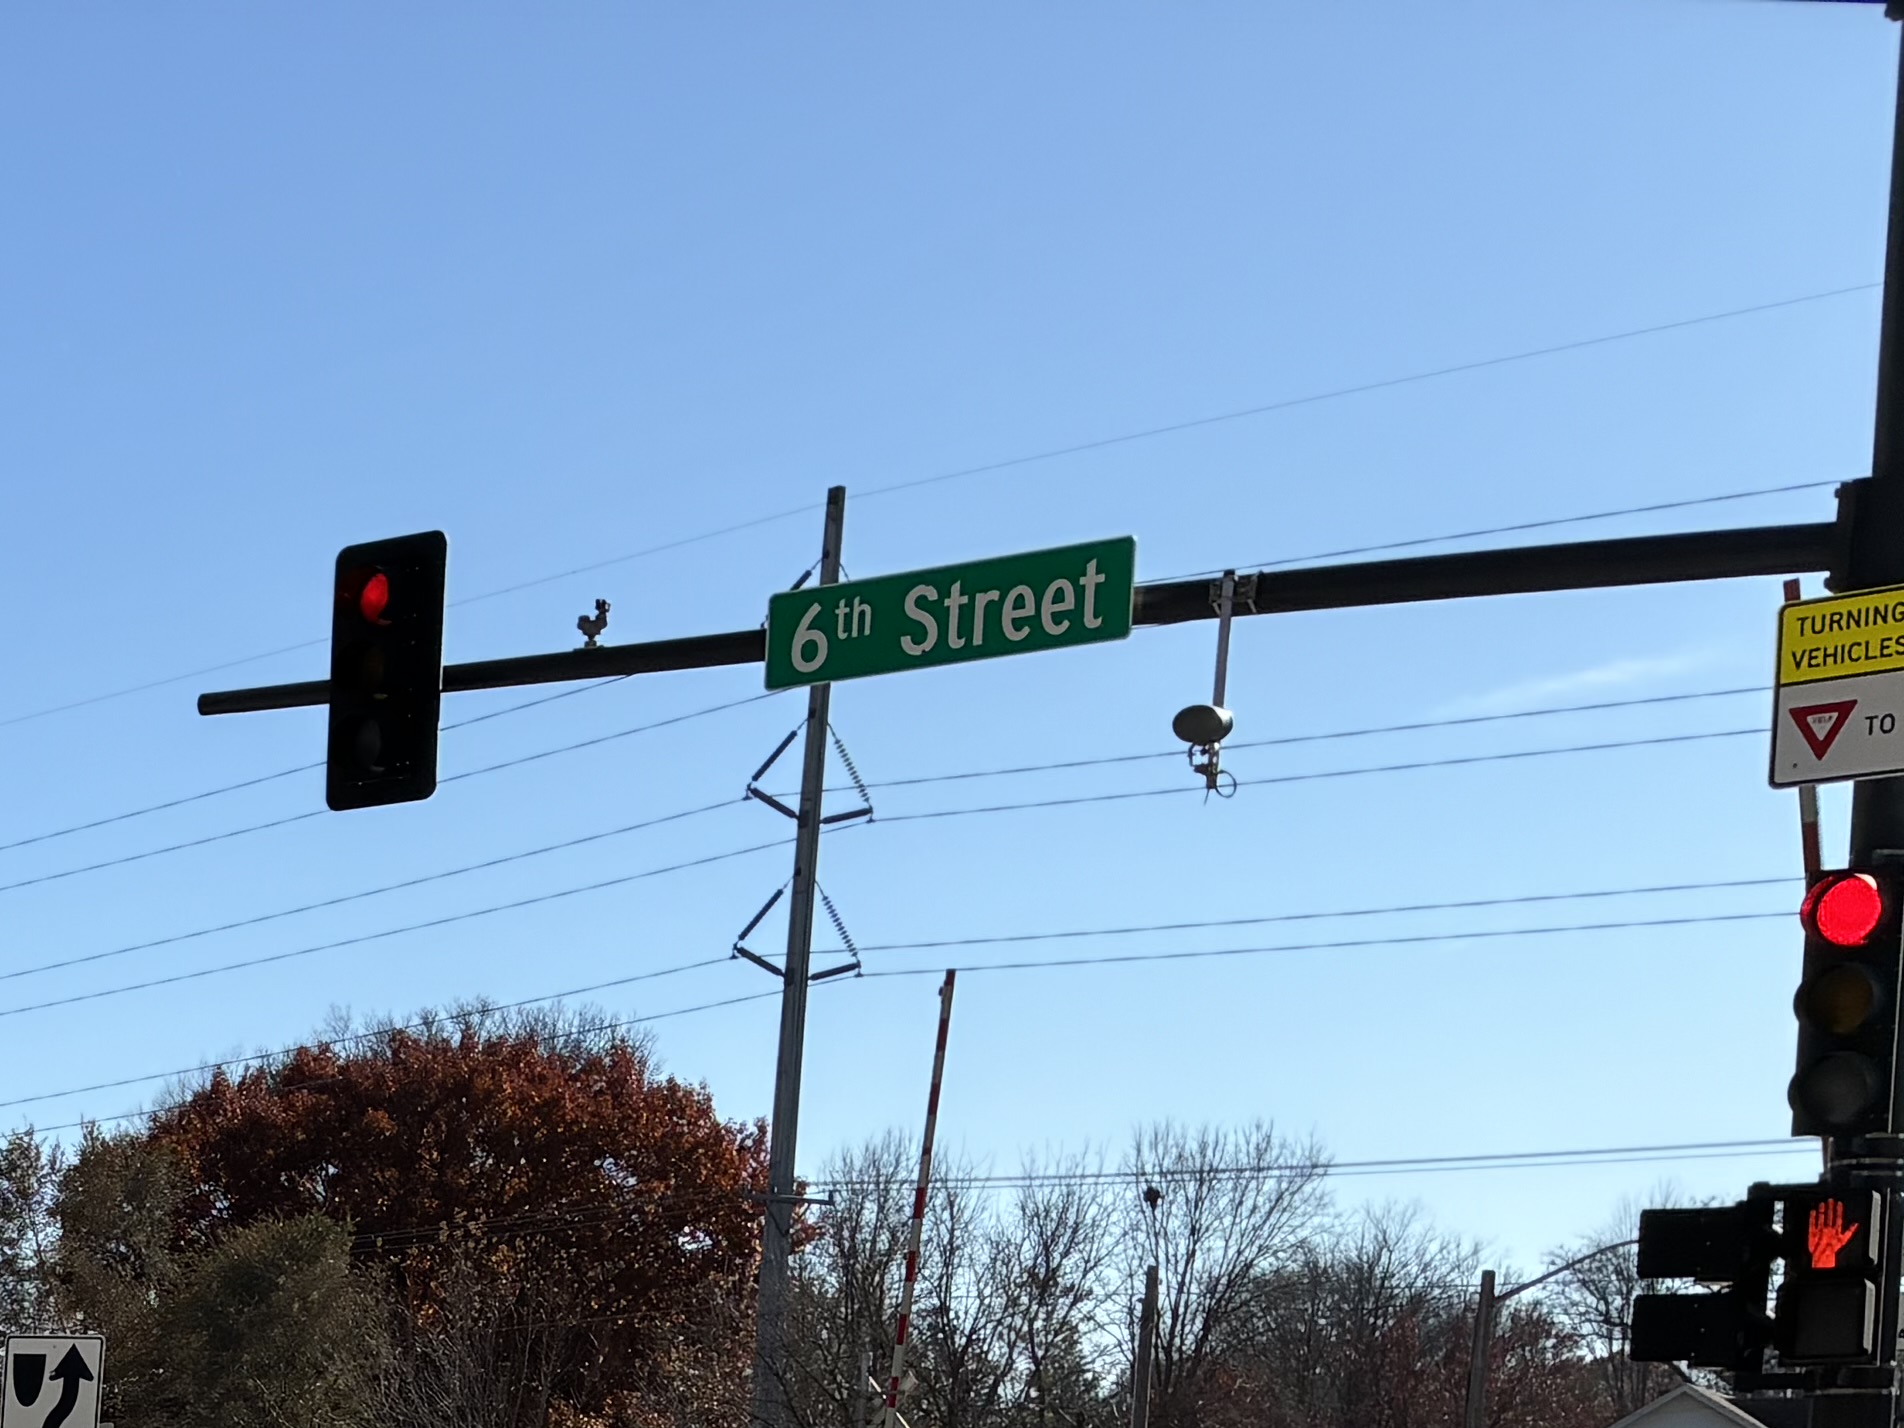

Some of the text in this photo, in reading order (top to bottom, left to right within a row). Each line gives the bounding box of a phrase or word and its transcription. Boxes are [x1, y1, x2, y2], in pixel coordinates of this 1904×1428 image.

[791, 558, 1106, 673] 6th Street
[1797, 602, 1904, 637] TURNING
[1792, 635, 1904, 670] VEHICLES
[1865, 713, 1896, 736] TO
